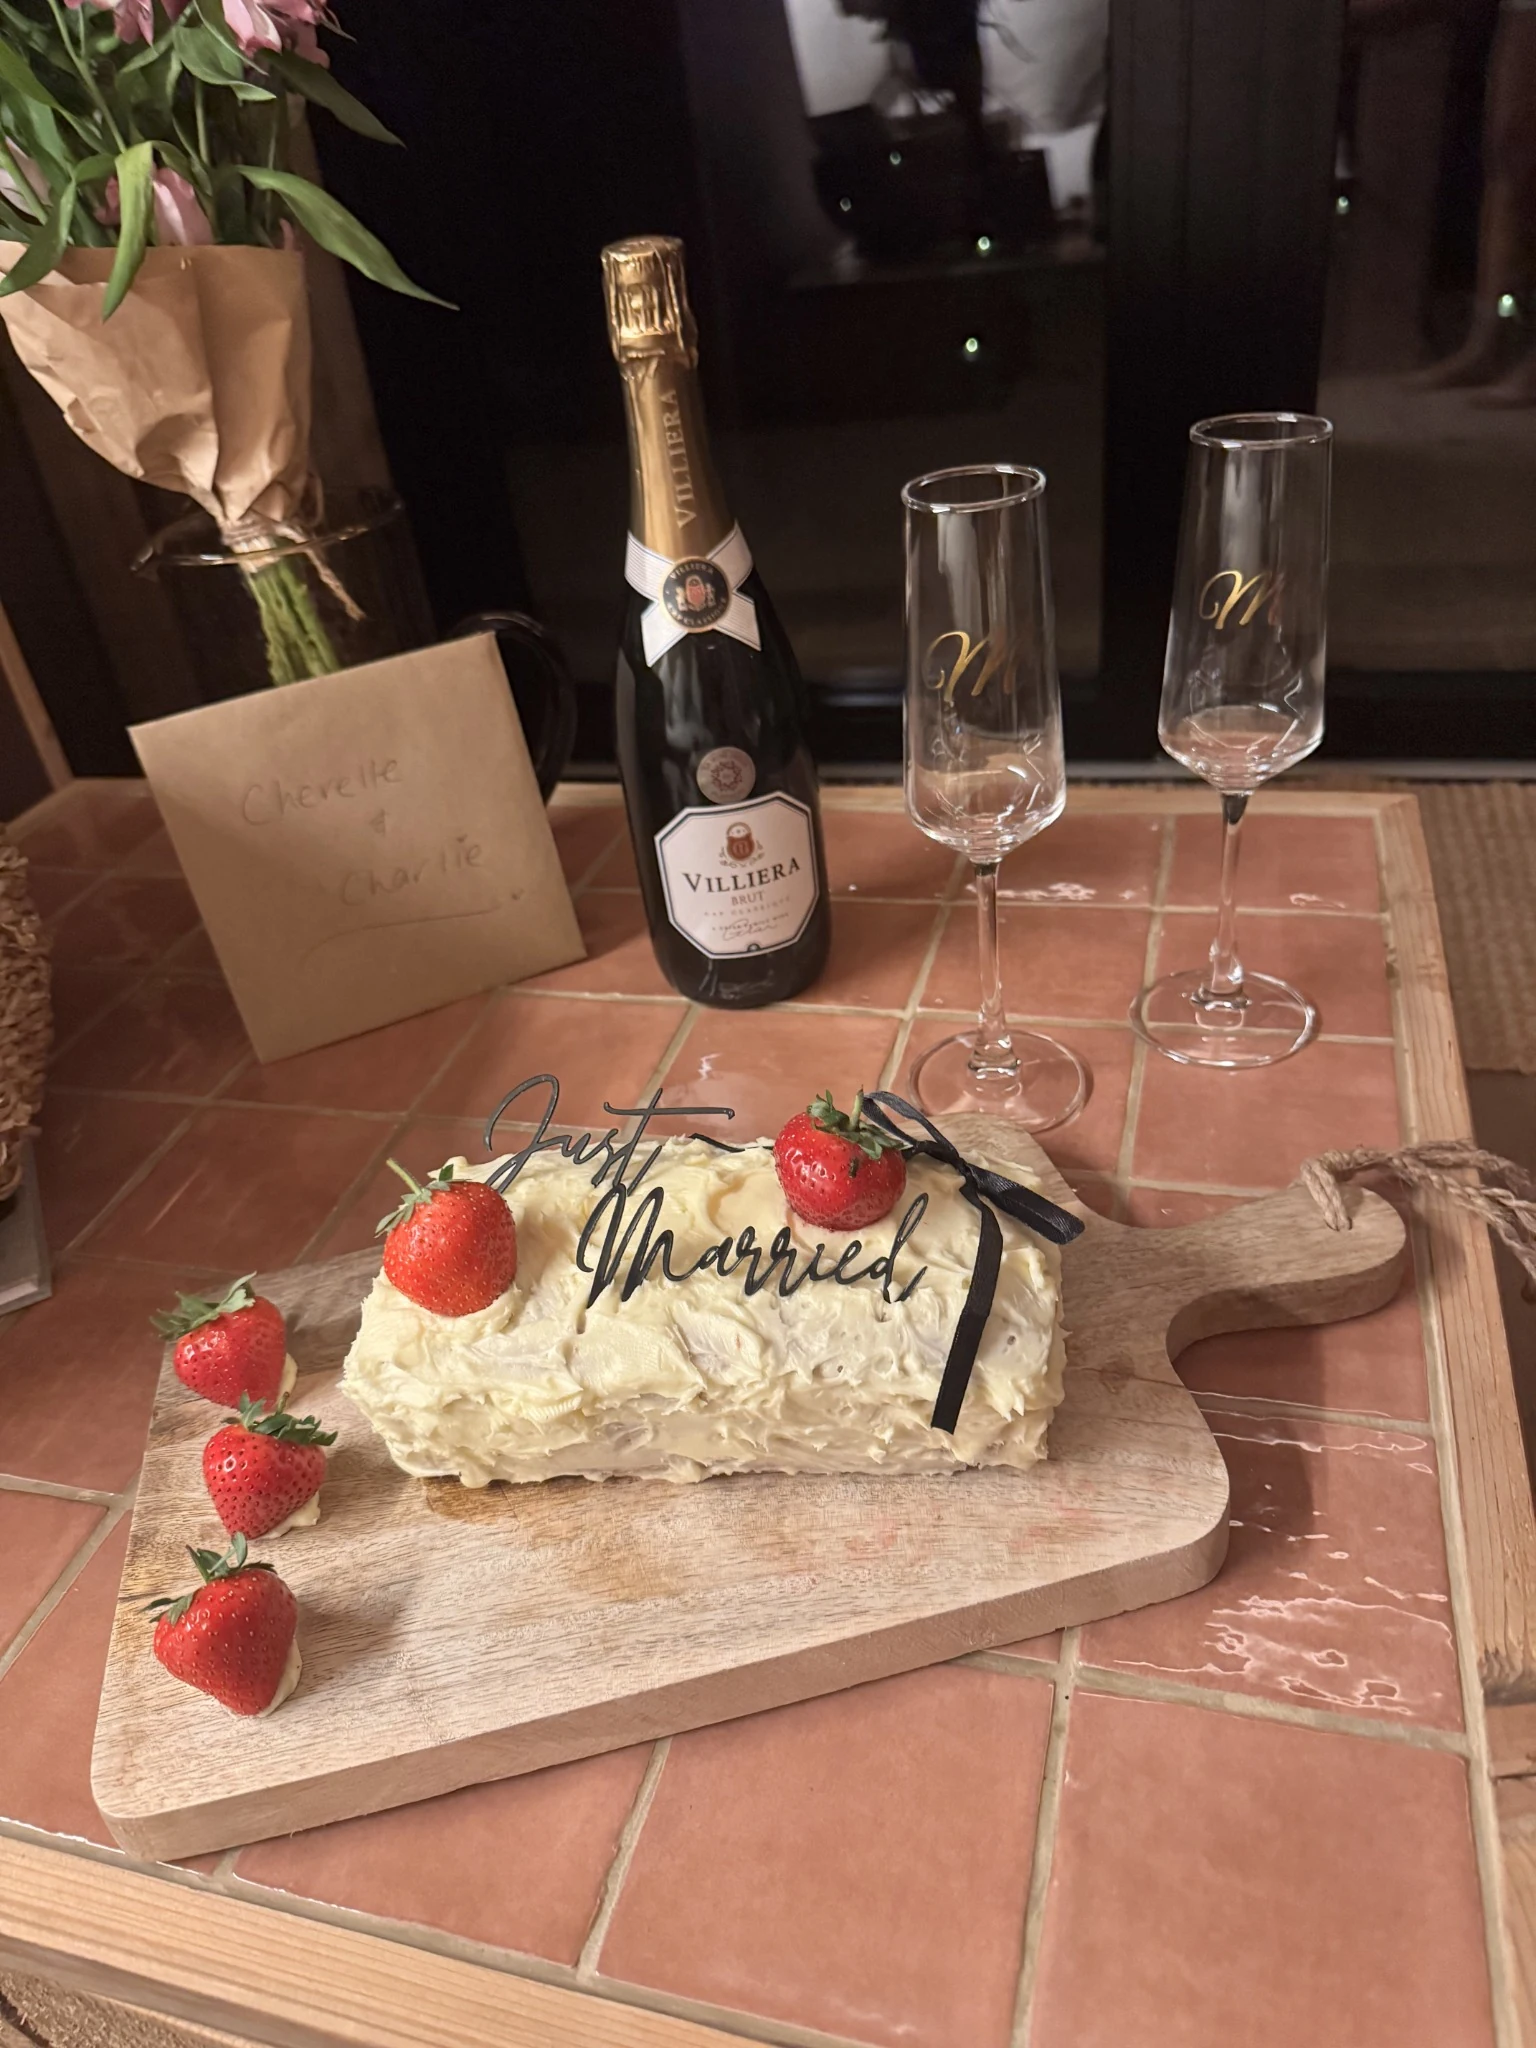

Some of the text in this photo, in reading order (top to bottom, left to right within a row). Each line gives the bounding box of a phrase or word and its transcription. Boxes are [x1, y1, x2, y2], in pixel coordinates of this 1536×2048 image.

[659, 389, 697, 529] VILLIERA
[341, 832, 483, 907] Charlie
[681, 856, 802, 893] VILLIERA
[730, 890, 766, 906] BRUT
[483, 1073, 736, 1195] Just
[576, 1182, 929, 1309] Married
